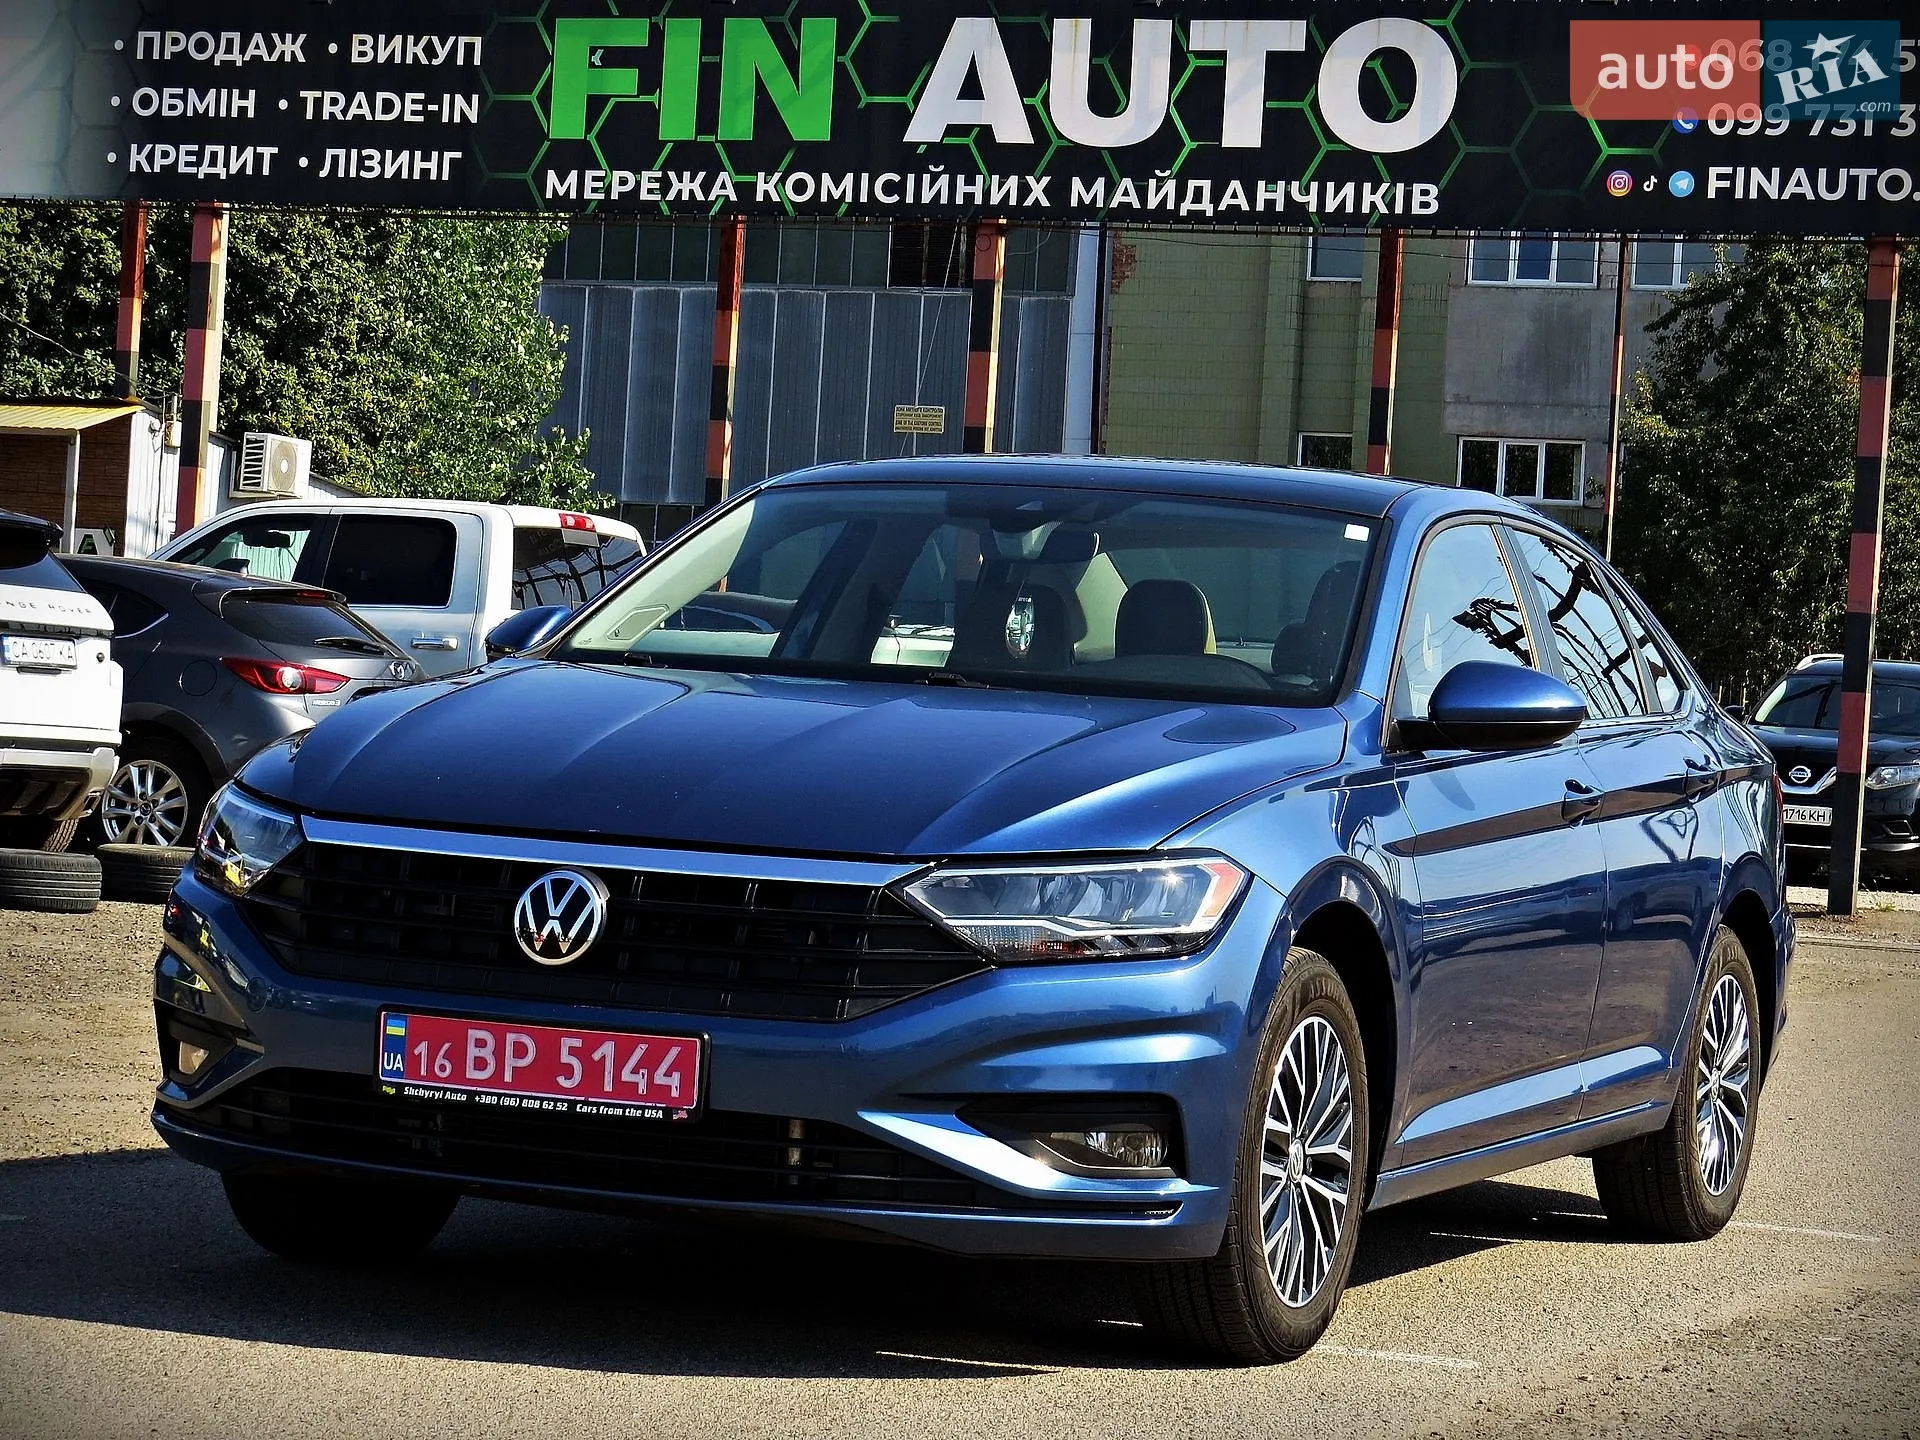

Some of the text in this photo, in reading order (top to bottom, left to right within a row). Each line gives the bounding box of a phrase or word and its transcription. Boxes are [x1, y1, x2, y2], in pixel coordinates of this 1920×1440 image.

[135, 31, 483, 66] ПРОДАЖ ВИКУП
[1890, 39, 1920, 73] 5
[549, 17, 1458, 153] FIN AUTO
[132, 87, 480, 124] ОБМІН TRADE-IN
[1707, 102, 1920, 137] 099 731 3
[129, 144, 462, 181] КРЕДИТ ЛІЗИНГ
[545, 164, 1440, 216] МЕРЕЖА КОМІСІЙНИХ МАЙДАНЧИКІВ
[383, 1052, 404, 1072] UA
[413, 1028, 682, 1098] 16 BP 5144
[445, 1091, 467, 1102] Auto
[474, 1095, 498, 1105] +380
[500, 1096, 520, 1107] (96)
[521, 1099, 541, 1109] 808
[542, 1101, 554, 1110] 62
[555, 1102, 568, 1112] 52
[576, 1103, 598, 1114] Cars
[599, 1105, 624, 1116] from
[624, 1107, 642, 1117] the
[644, 1108, 664, 1119] USA
